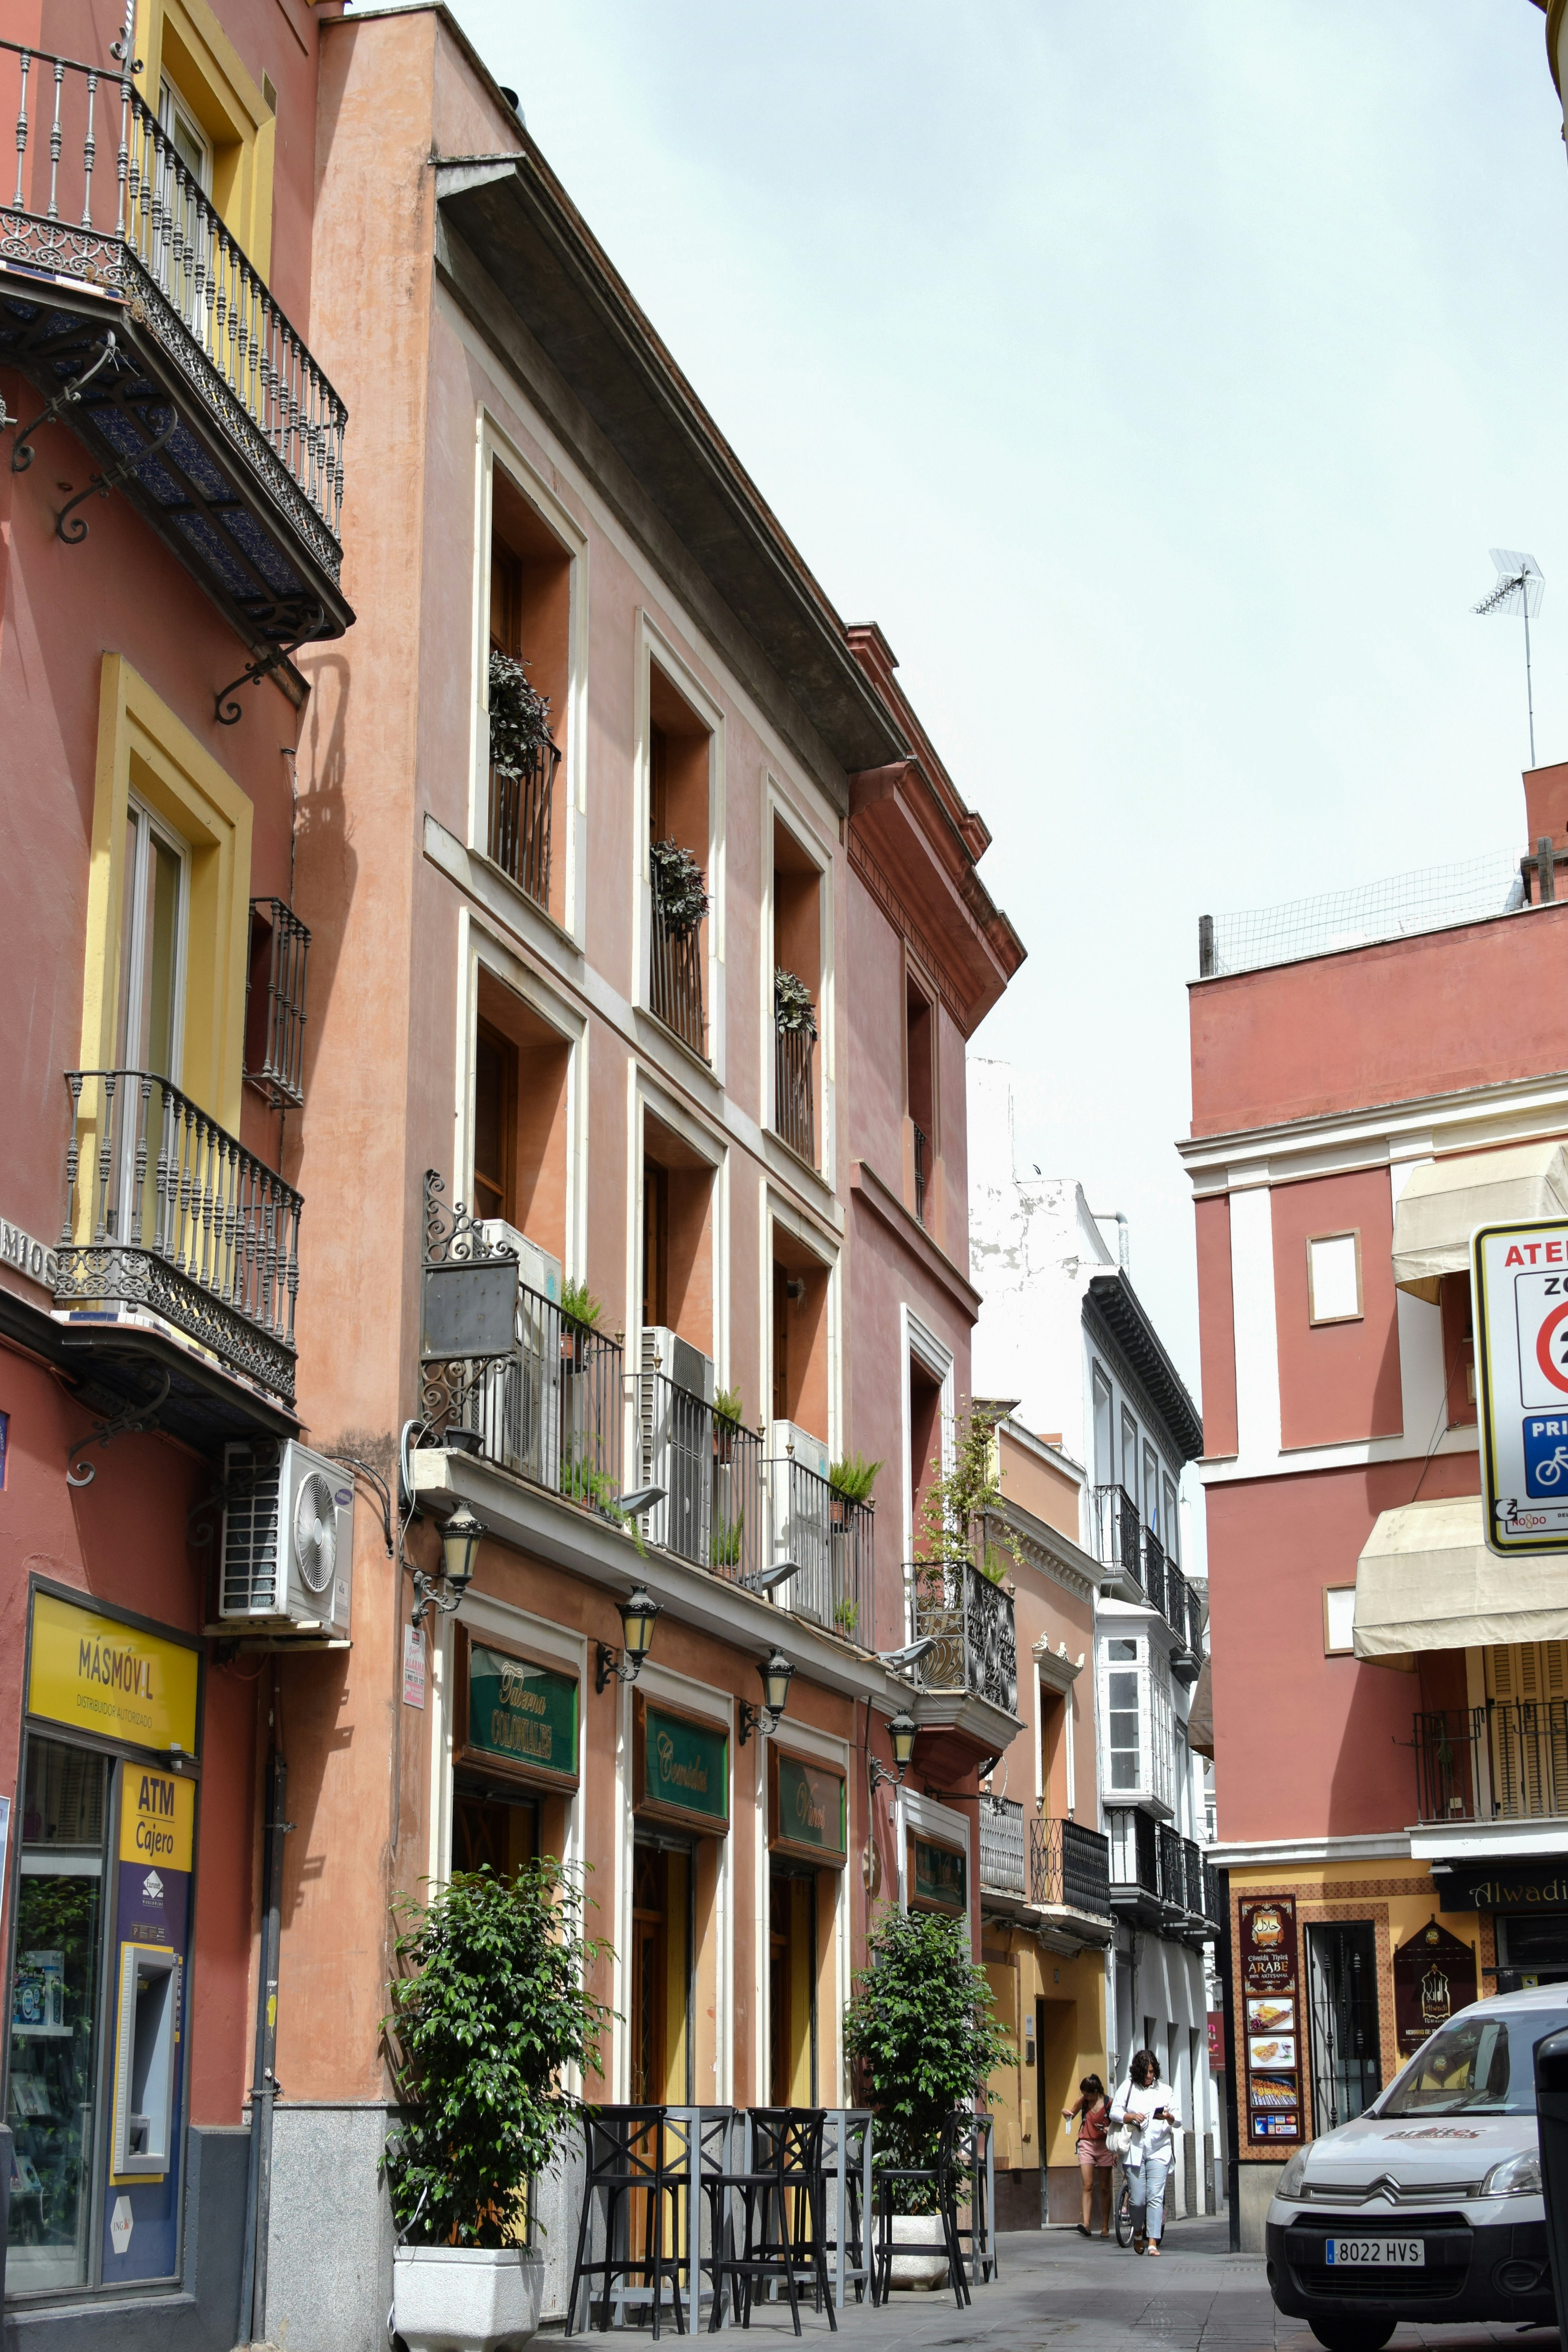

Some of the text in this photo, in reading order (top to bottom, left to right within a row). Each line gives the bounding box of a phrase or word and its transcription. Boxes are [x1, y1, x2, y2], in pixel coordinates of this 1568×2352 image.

[0, 1220, 57, 1286] MIOS
[1505, 1240, 1568, 1267] ATE
[337, 1491, 351, 1503] SAMSUNG
[405, 1658, 424, 1673] ALARMA
[499, 1662, 546, 1715] Taberna
[77, 1694, 152, 1728] DISTRIBUIDOR AUTORIZADO
[491, 1709, 552, 1759] COLONIALES
[657, 1731, 707, 1793] Comidas
[138, 1776, 174, 1816] ATM
[136, 1821, 173, 1857] Cajero
[147, 1879, 160, 1889] Euronet
[1469, 1879, 1568, 1907] Alwadi
[1257, 1919, 1278, 1932] حلال
[1248, 1962, 1288, 1974] ARABE
[114, 2221, 123, 2231] ING
[1340, 2243, 1380, 2261] 8022
[1387, 2243, 1419, 2262] HVS
